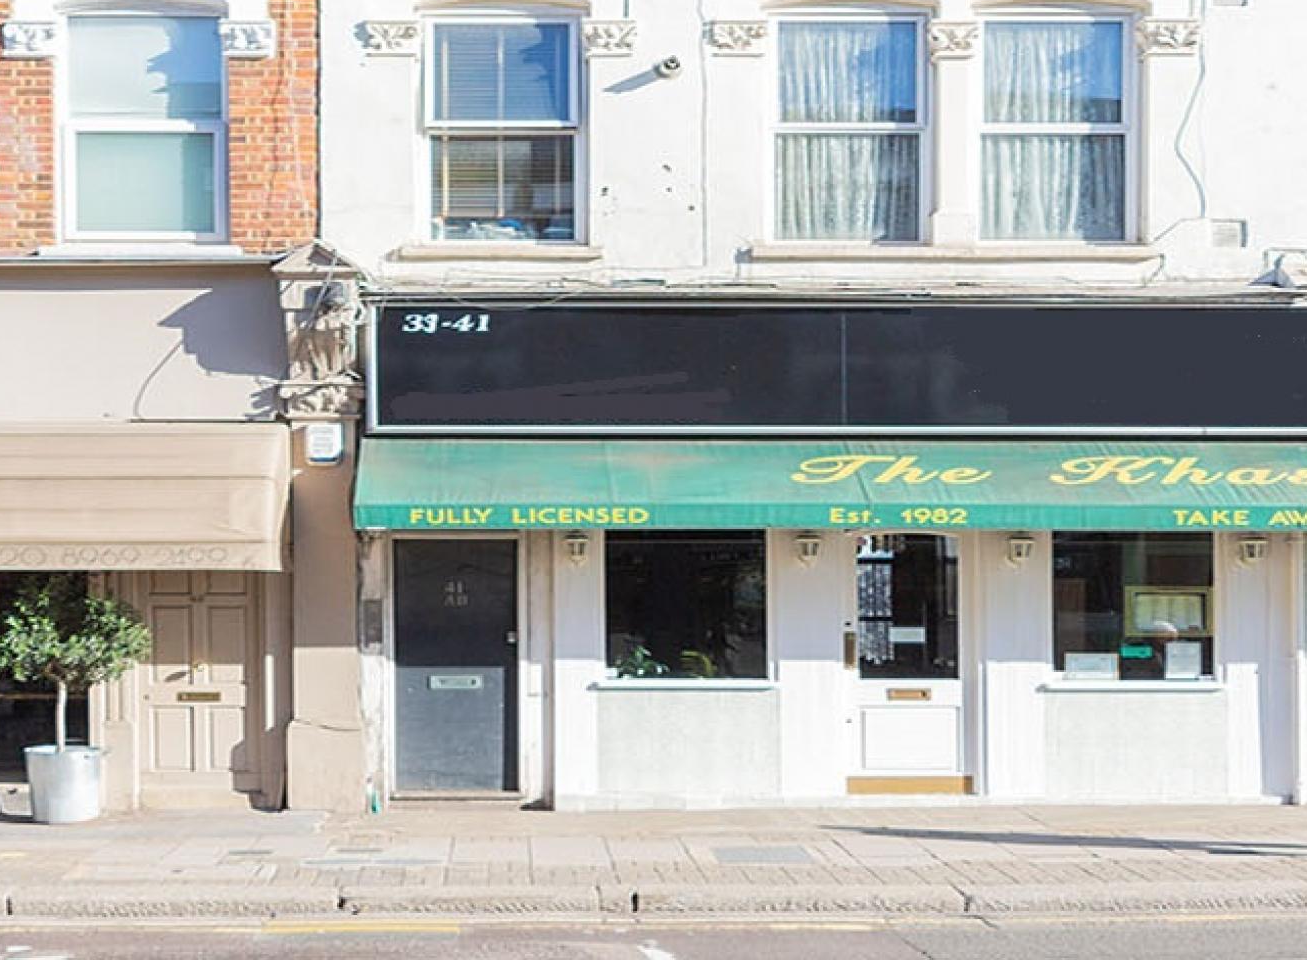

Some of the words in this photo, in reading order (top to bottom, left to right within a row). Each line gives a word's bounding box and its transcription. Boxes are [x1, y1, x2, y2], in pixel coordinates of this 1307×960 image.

[791, 455, 992, 484] The
[409, 508, 493, 525] FULLY
[511, 508, 650, 525] LICENSED
[829, 507, 882, 525] Est.
[900, 507, 969, 525] 1982
[1173, 509, 1251, 527] TAKE
